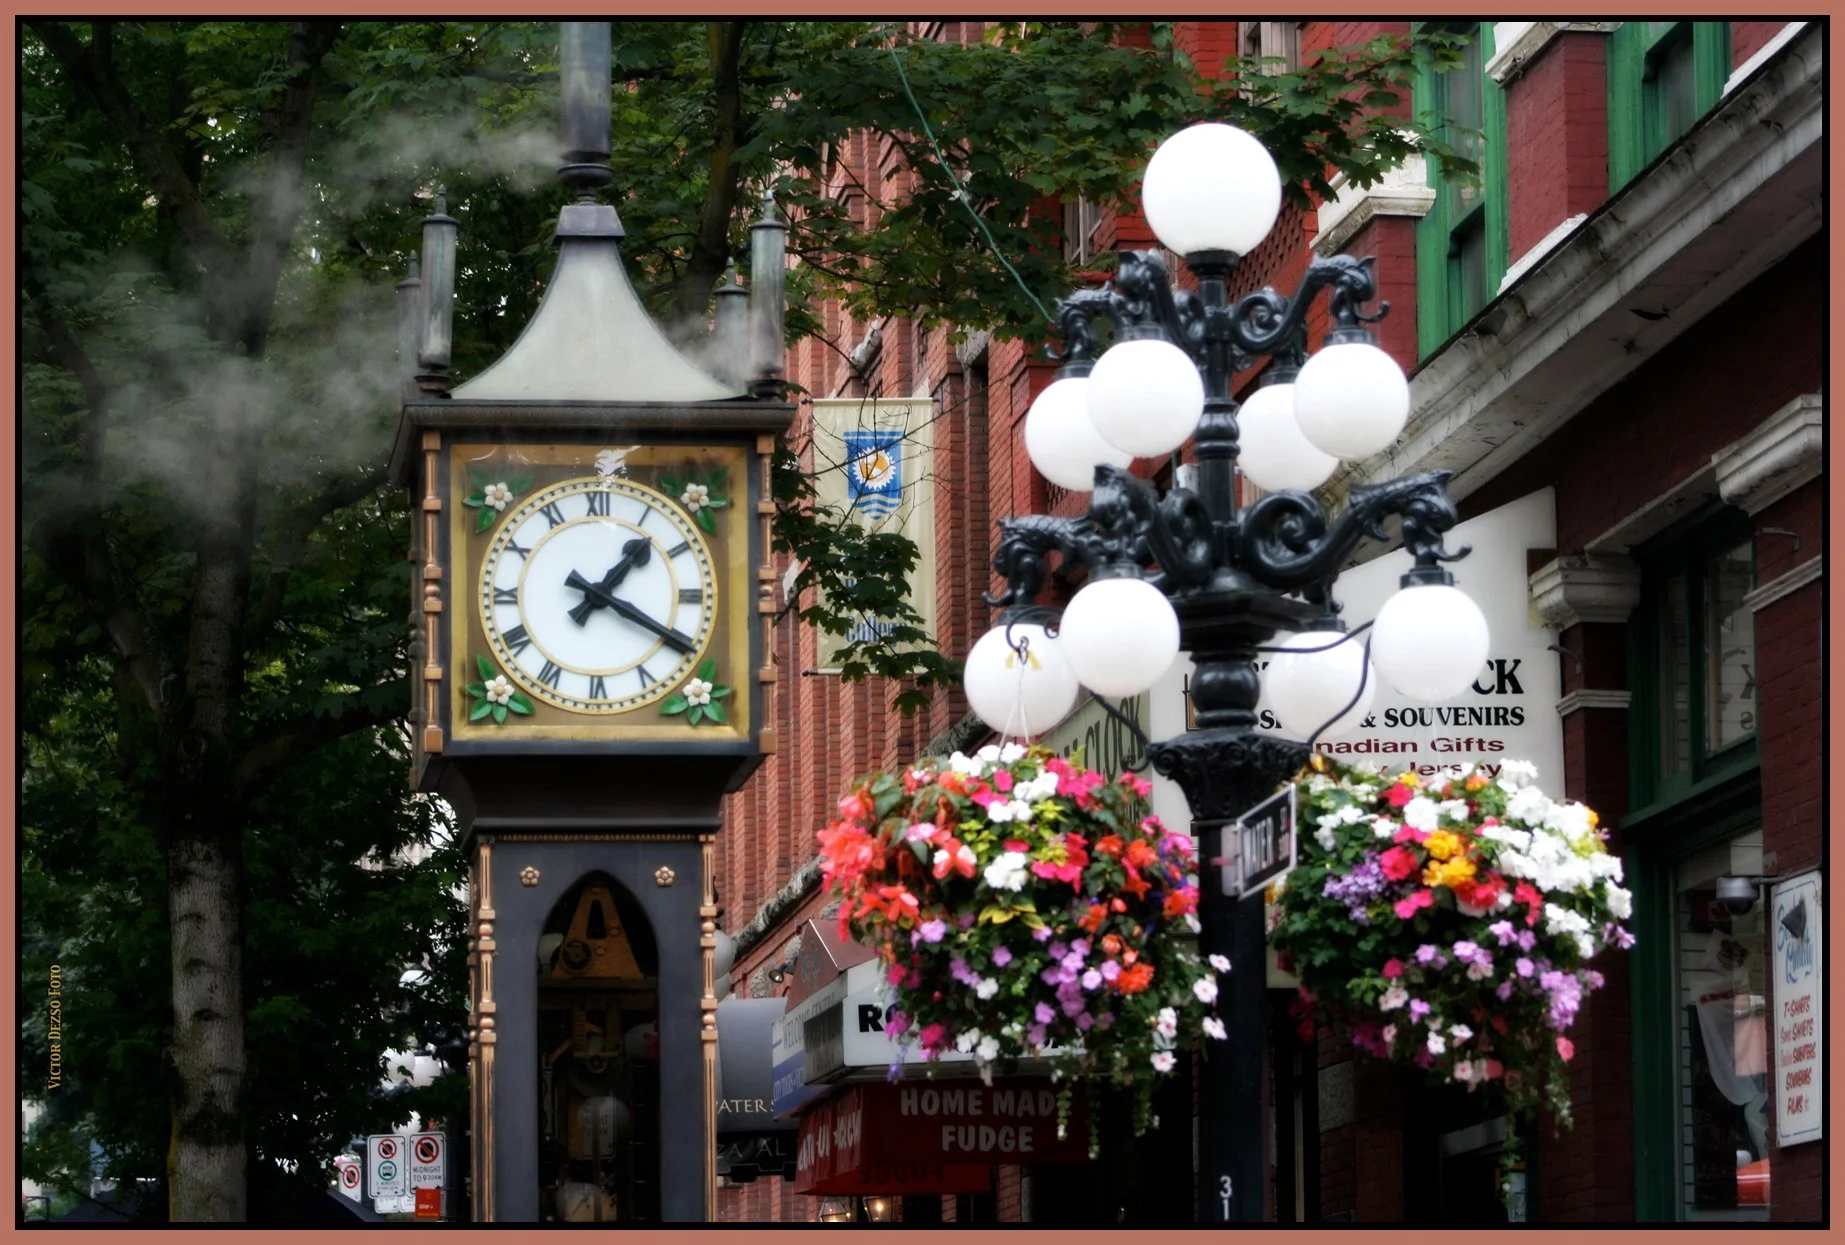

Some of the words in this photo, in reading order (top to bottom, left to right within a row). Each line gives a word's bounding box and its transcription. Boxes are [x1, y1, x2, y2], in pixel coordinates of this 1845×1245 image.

[1384, 705, 1526, 729] SOUVENIRS
[1084, 694, 1144, 786] CLOCK
[1314, 738, 1418, 756] nadian
[1430, 736, 1505, 754] Gifts
[716, 1098, 767, 1115] ATER
[900, 1088, 984, 1117] HOME
[992, 1088, 1070, 1119] MAD
[941, 1125, 1034, 1153] FUDGE
[412, 1165, 441, 1174] MIDNIGHT
[413, 1174, 422, 1182] TO
